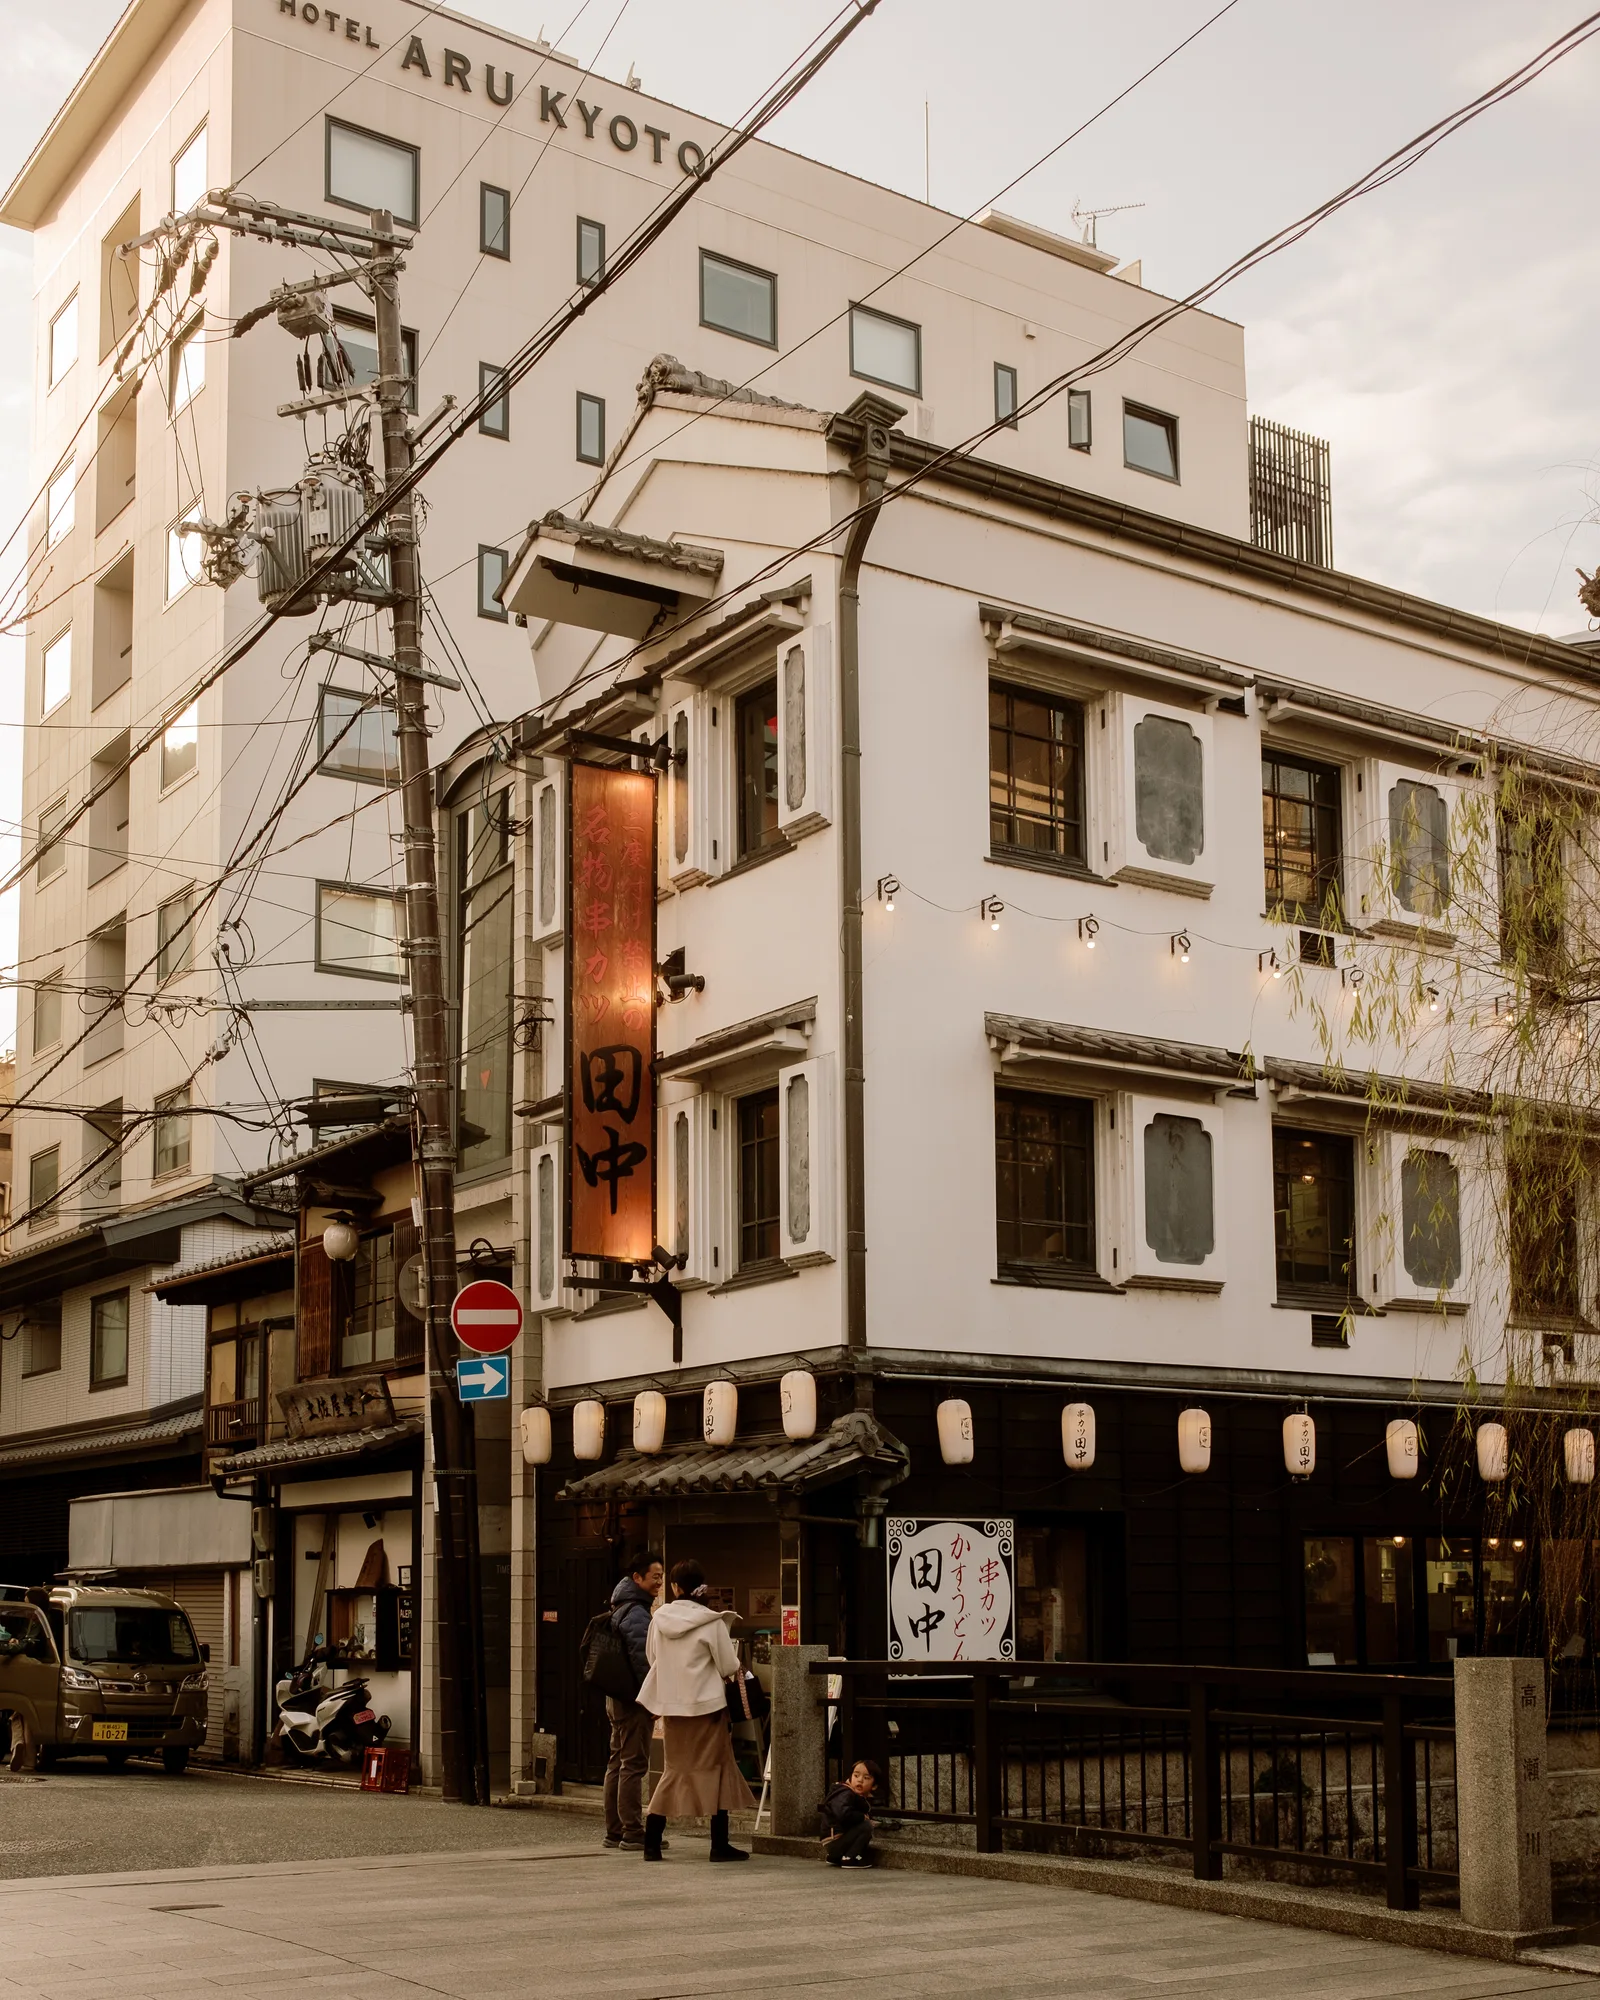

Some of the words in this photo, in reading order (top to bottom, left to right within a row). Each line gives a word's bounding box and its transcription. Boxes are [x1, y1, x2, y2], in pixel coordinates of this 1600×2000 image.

[280, 0, 380, 49] HOTEL
[401, 34, 515, 106] ARU
[539, 85, 707, 178] KYOTO
[577, 804, 614, 1025] 名物串カツ
[620, 811, 647, 1031] 二度付け禁止の
[575, 1043, 648, 1216] 田中
[1074, 1409, 1087, 1463] 串カツ田中
[1299, 1419, 1310, 1469] 串カツ田中
[907, 1548, 946, 1653] 田中
[950, 1533, 971, 1660] かすうどん
[978, 1558, 999, 1636] 串カツ
[101, 1729, 126, 1739] 10-27
